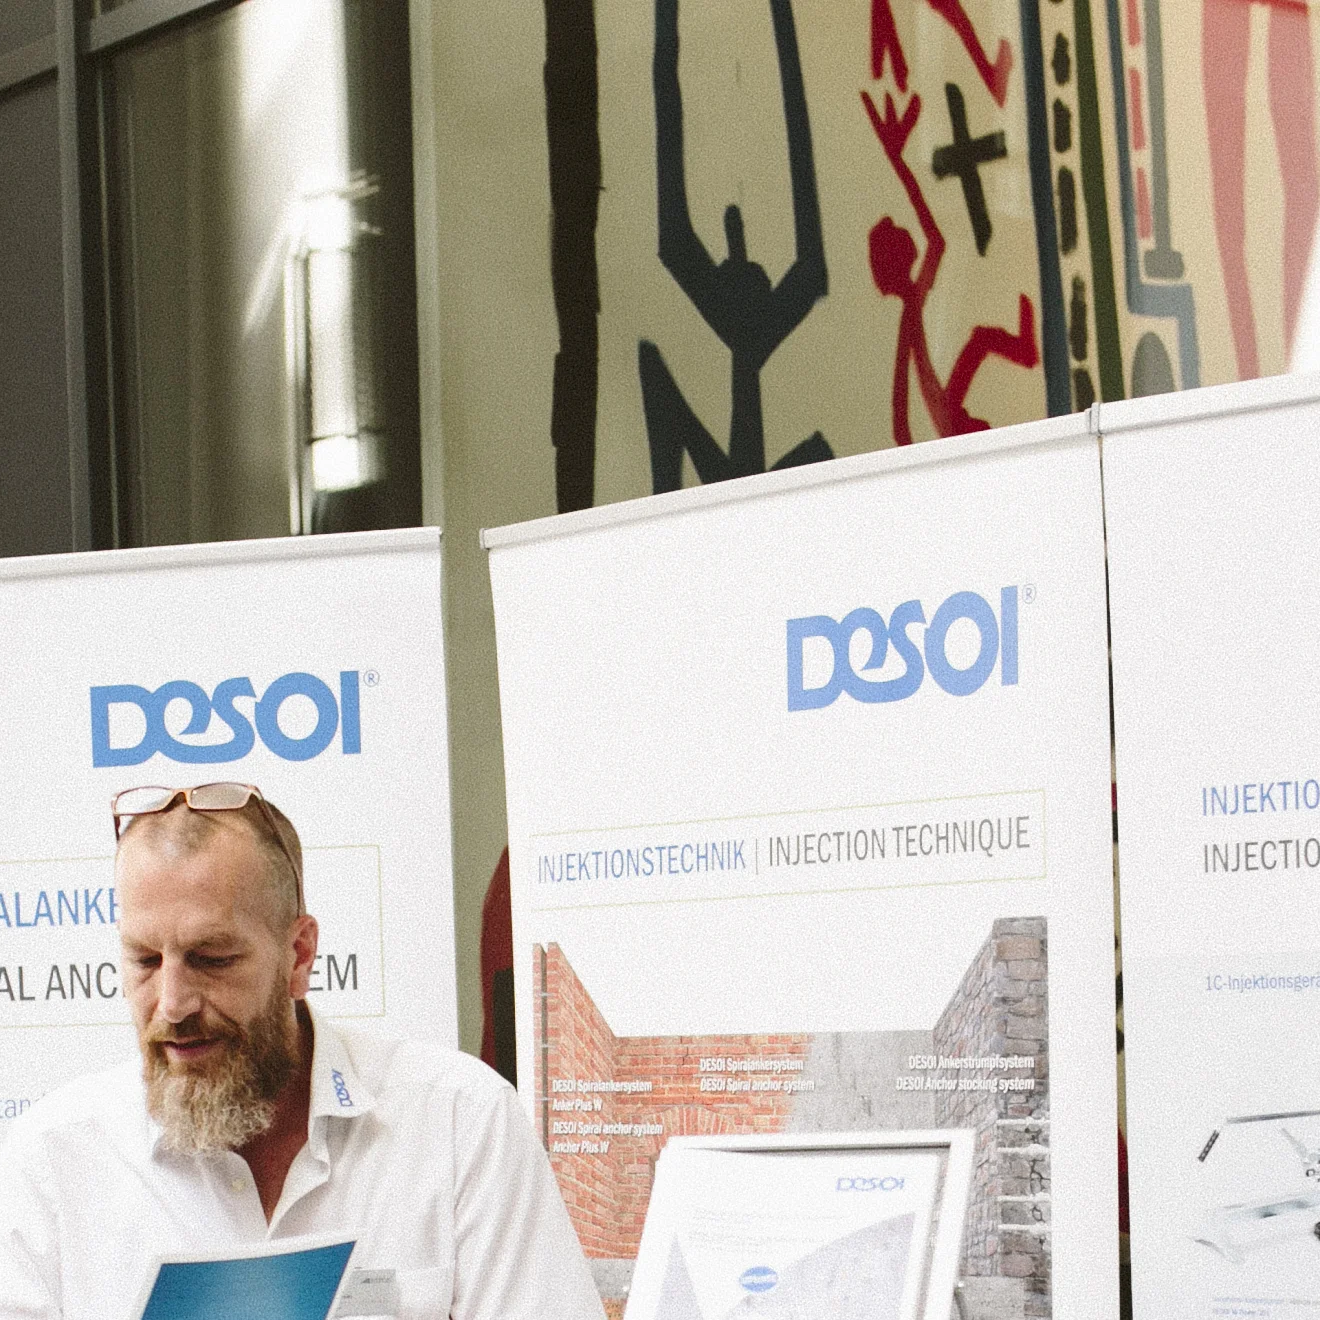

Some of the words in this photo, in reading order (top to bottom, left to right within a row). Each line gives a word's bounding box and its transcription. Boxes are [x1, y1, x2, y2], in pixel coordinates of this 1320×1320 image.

[538, 840, 747, 884] INJEKTIONSTECHNIK
[768, 828, 886, 868] INJECTION
[892, 816, 1031, 858] TECHNIQUE
[700, 1058, 726, 1072] DESOI
[727, 1057, 804, 1075] Spiralankersystem
[908, 1055, 936, 1070] DESOI
[552, 1079, 576, 1092] DESOI
[700, 1078, 726, 1092] DESOI
[727, 1078, 751, 1093] Spiral
[752, 1079, 781, 1092] anchor
[783, 1079, 815, 1094] system
[896, 1078, 924, 1091] DESOI
[925, 1077, 957, 1091] Anchor
[958, 1077, 998, 1093] stocking
[999, 1078, 1035, 1094] system
[553, 1121, 577, 1134] DESOI
[578, 1121, 602, 1136] Spiral
[603, 1122, 634, 1135] anchor
[634, 1123, 663, 1137] system
[553, 1141, 581, 1153] Anchor
[581, 1141, 599, 1153] Plus
